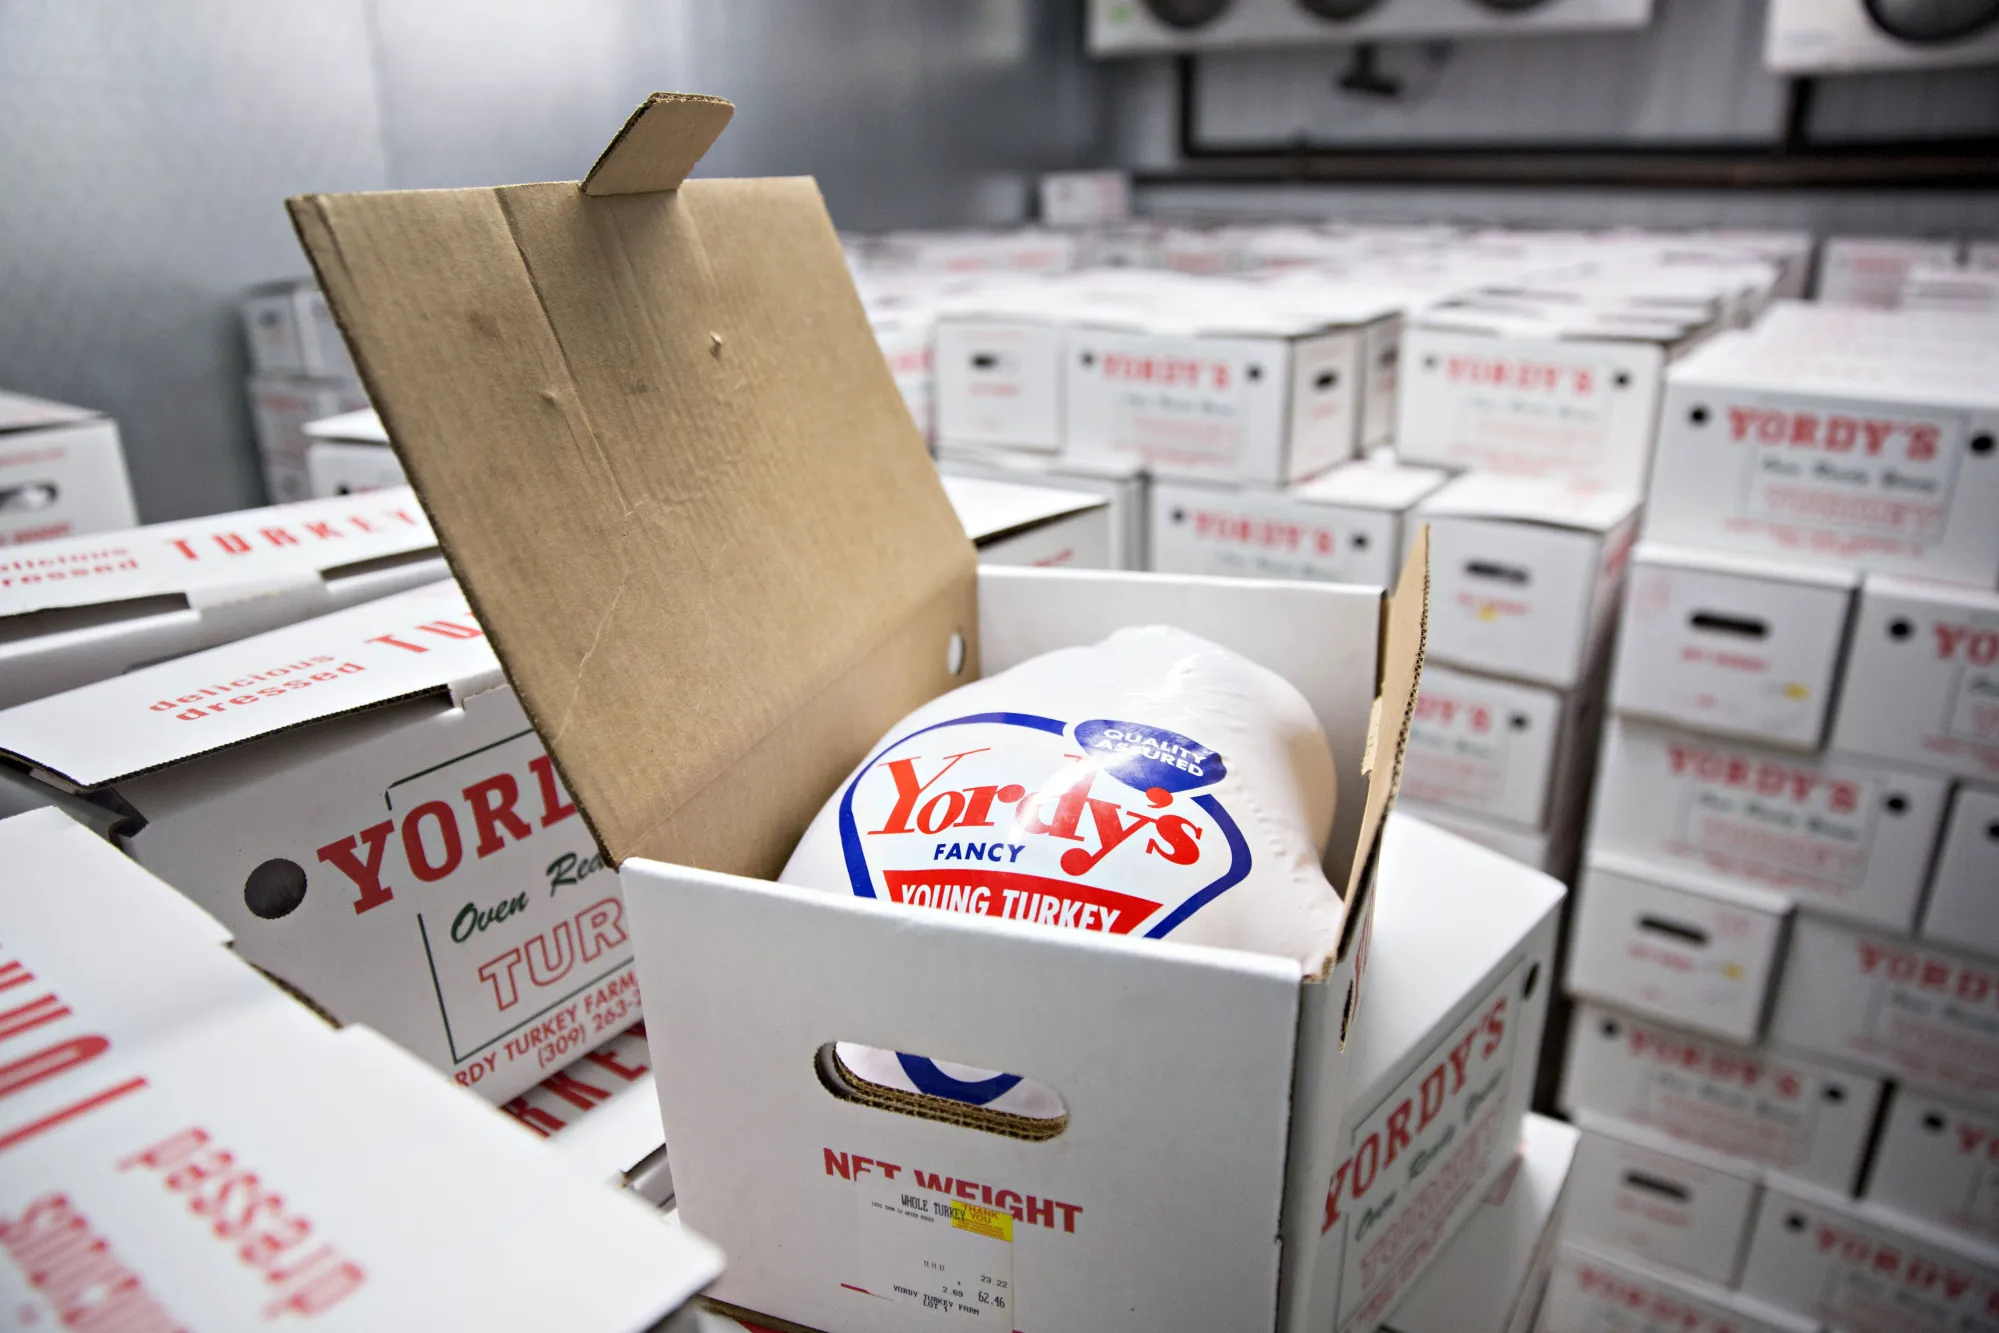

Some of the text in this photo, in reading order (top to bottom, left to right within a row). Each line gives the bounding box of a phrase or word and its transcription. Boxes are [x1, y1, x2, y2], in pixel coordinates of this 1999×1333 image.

[1727, 404, 1942, 462] YORDY'S
[165, 511, 416, 561] TURKEY
[364, 611, 484, 654] TU
[148, 654, 336, 712] delicious
[176, 661, 367, 721] dressed
[1094, 739, 1204, 777] ASSURED
[1103, 729, 1208, 764] QUALITY
[867, 746, 1202, 876] Yordy's
[933, 842, 1026, 864] FANCY
[450, 891, 529, 944] Oven
[901, 884, 1121, 933] YOUNG TURKEY
[504, 1003, 578, 1061] TURKEY
[537, 1024, 587, 1069] (309)
[901, 1193, 967, 1222] WHOLE TURKEY
[913, 1169, 1084, 1234] WEIGHT
[962, 1203, 999, 1220] THANK
[970, 1213, 992, 1224] YOU
[114, 1127, 367, 1322] dressed
[893, 1284, 980, 1316] YORDY TURKEY FARM
[942, 1286, 1006, 1308] 2.69 62.46
[980, 1275, 1008, 1288] 23.22
[923, 1299, 939, 1311] LOT
